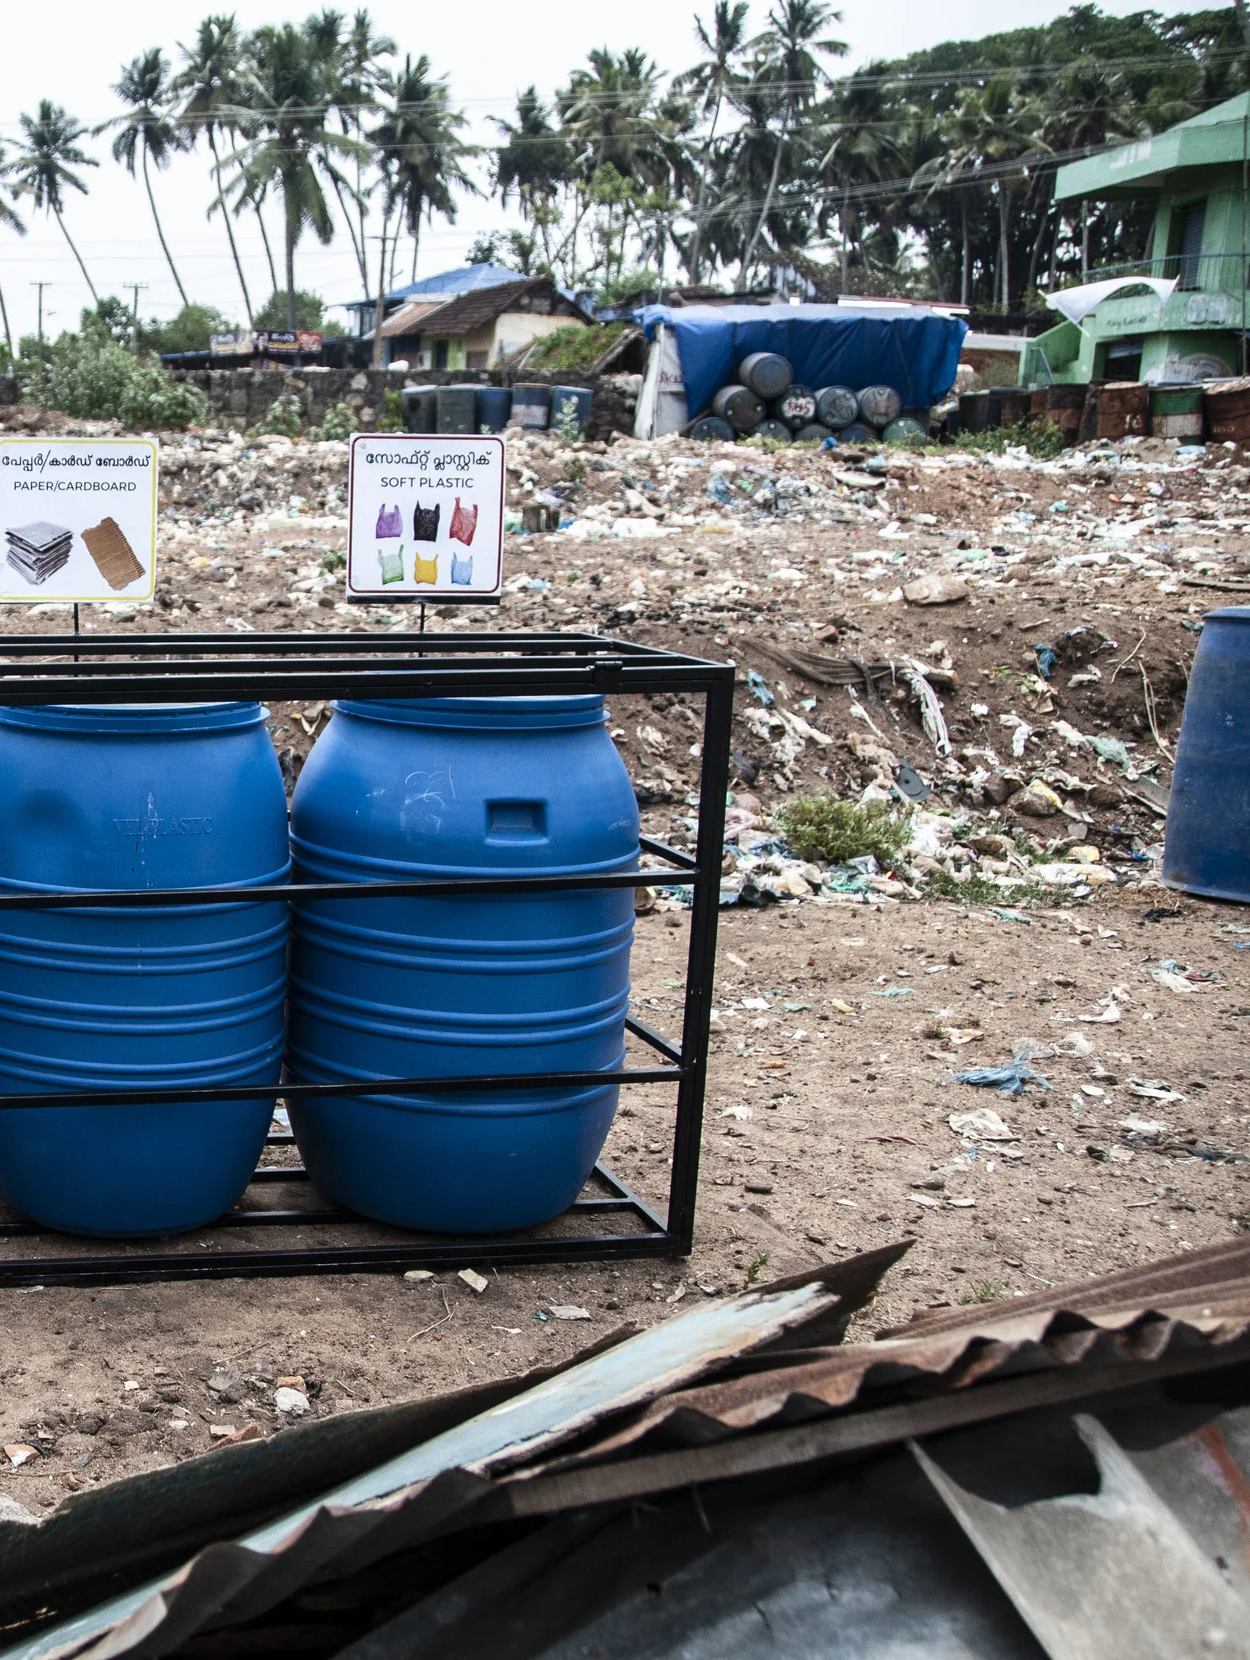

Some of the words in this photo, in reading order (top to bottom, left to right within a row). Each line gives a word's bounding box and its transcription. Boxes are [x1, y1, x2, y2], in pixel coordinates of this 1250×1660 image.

[1, 450, 93, 473] പേപ്പർ/കാർഡ്
[95, 455, 151, 467] ബോർഡ്
[366, 450, 430, 471] സോഫ്റ്റ്
[434, 451, 492, 471] പ്ലാസ്റ്റിക്
[13, 480, 137, 491] PAPER/CARDBOARD
[381, 477, 416, 487] SOFT
[419, 478, 474, 488] PLASTIC
